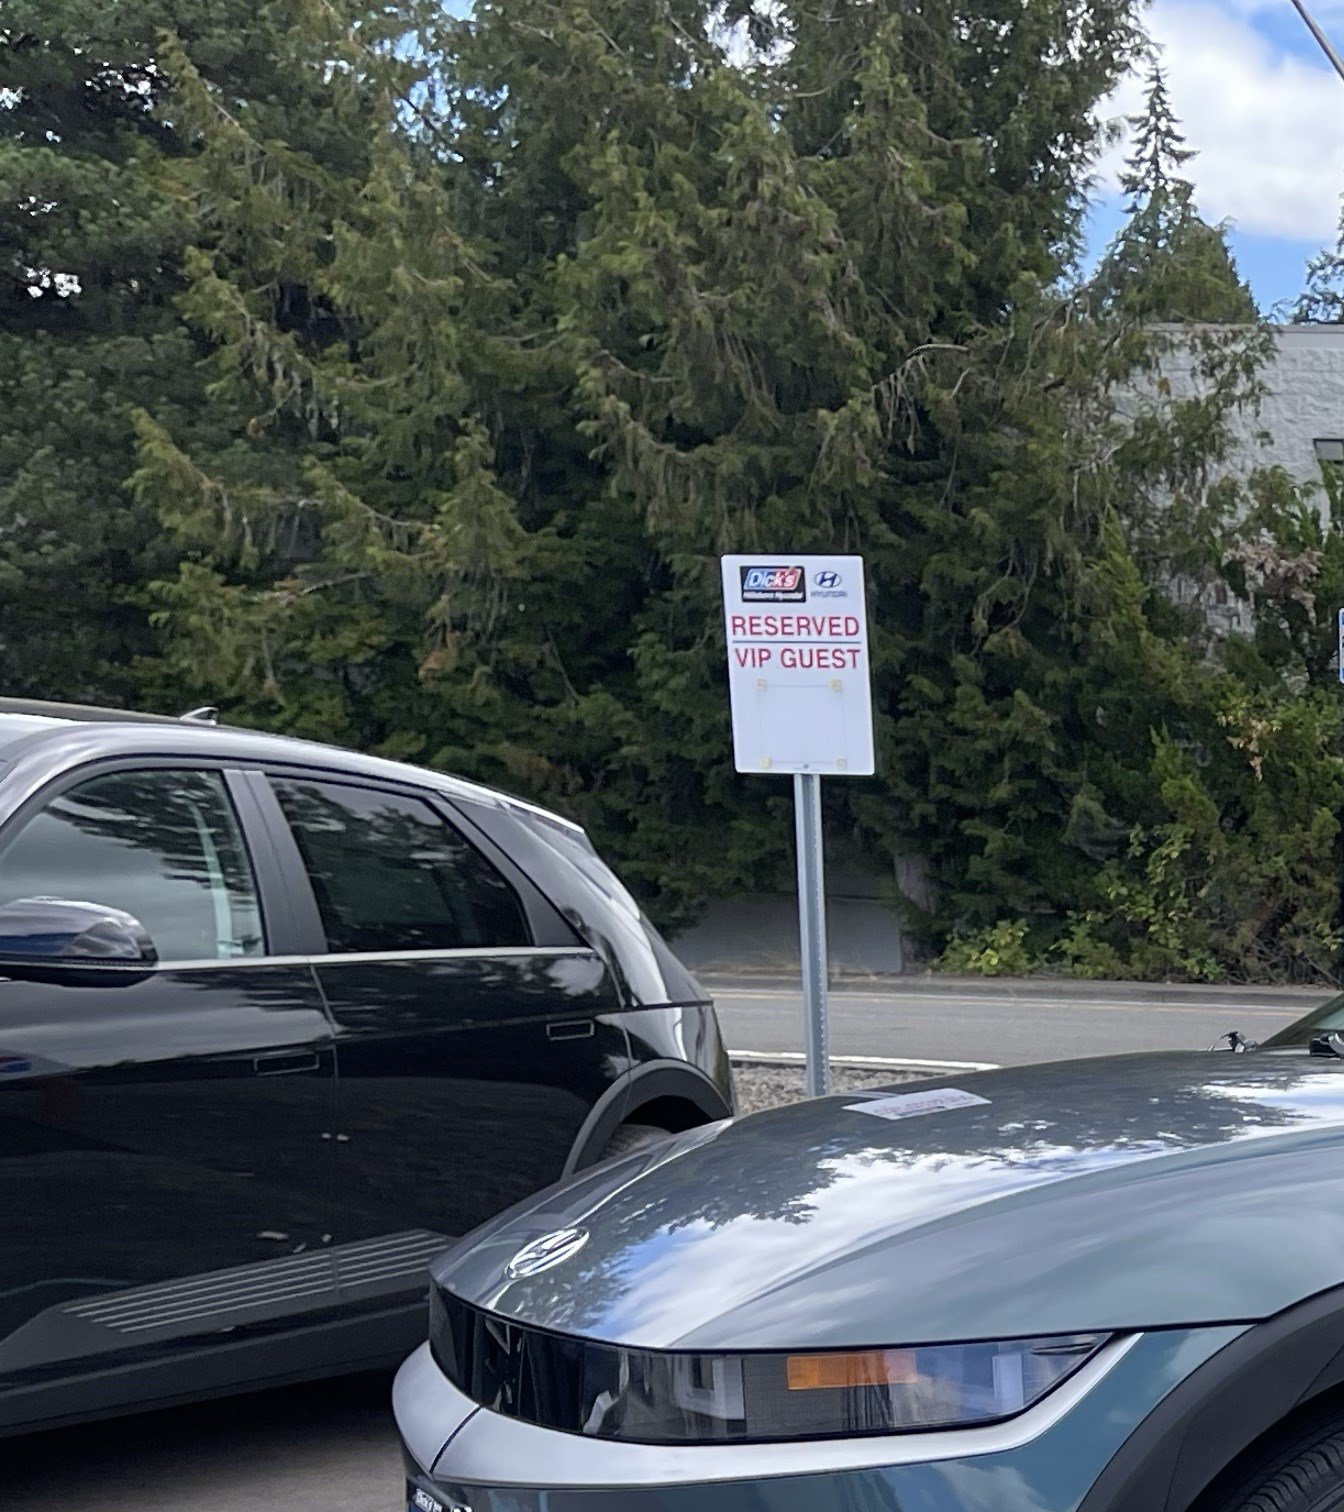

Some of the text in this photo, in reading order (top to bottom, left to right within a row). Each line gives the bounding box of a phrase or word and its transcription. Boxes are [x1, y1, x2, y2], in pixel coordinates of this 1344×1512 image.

[731, 615, 860, 637] RESERVED
[734, 648, 861, 670] VIP GUEST
